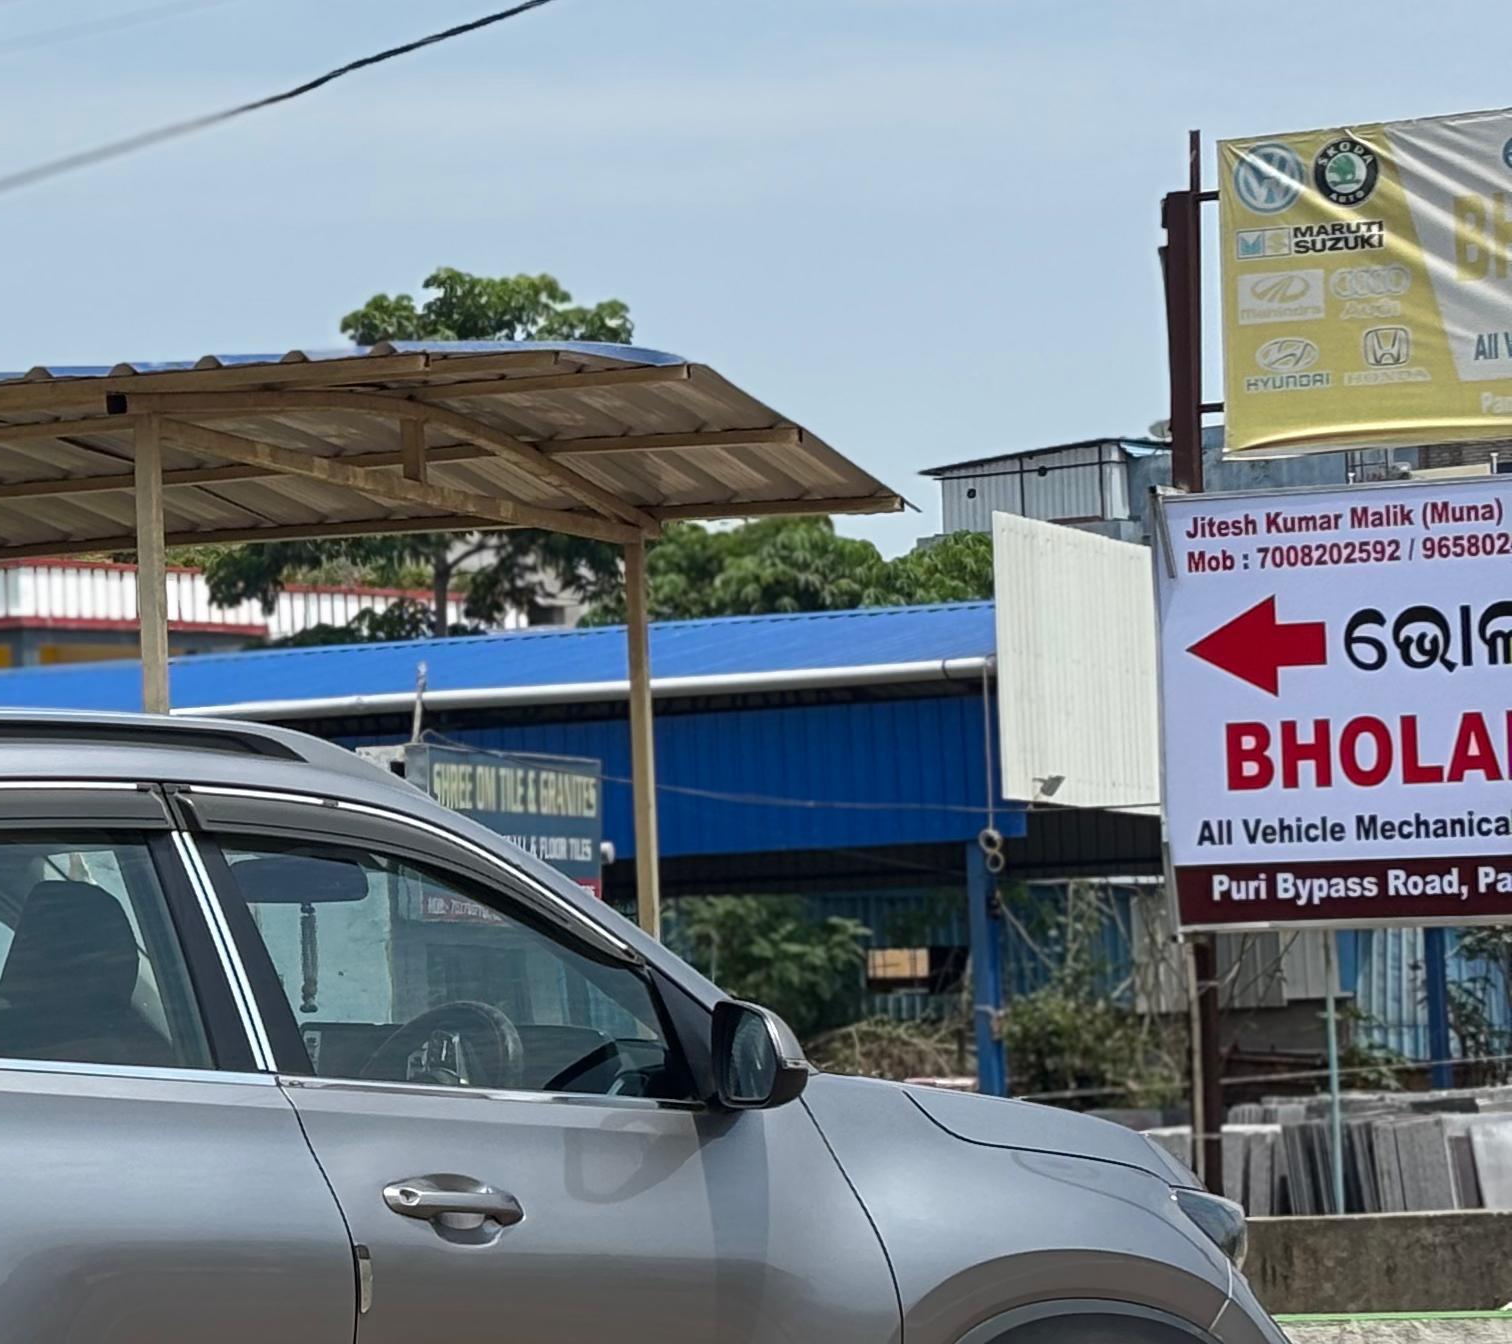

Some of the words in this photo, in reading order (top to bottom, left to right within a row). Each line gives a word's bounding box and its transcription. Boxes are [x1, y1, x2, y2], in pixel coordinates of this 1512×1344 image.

[1293, 221, 1384, 238] MARUTI
[1294, 234, 1384, 254] SUZUKI
[1474, 333, 1499, 361] All
[1246, 373, 1330, 392] HYUNDAI
[1186, 513, 1257, 539] Jitesh
[1265, 510, 1343, 535] Kumar
[1350, 504, 1415, 530] Malik
[1422, 498, 1503, 530] (Muna)
[1187, 549, 1235, 573] Mob
[1256, 540, 1401, 570] 7008202592
[1421, 532, 1512, 559] 965802
[1225, 709, 1512, 791] BHOLA
[499, 767, 525, 813] TILE
[1197, 819, 1232, 847] All
[1241, 815, 1346, 844] Vehicle
[1356, 808, 1512, 841] Mechanica
[540, 837, 567, 860] FLOOR
[569, 838, 592, 862] TILES
[1211, 873, 1267, 901] Puri
[1276, 871, 1378, 905] Bypass
[1387, 868, 1469, 899] Road,
